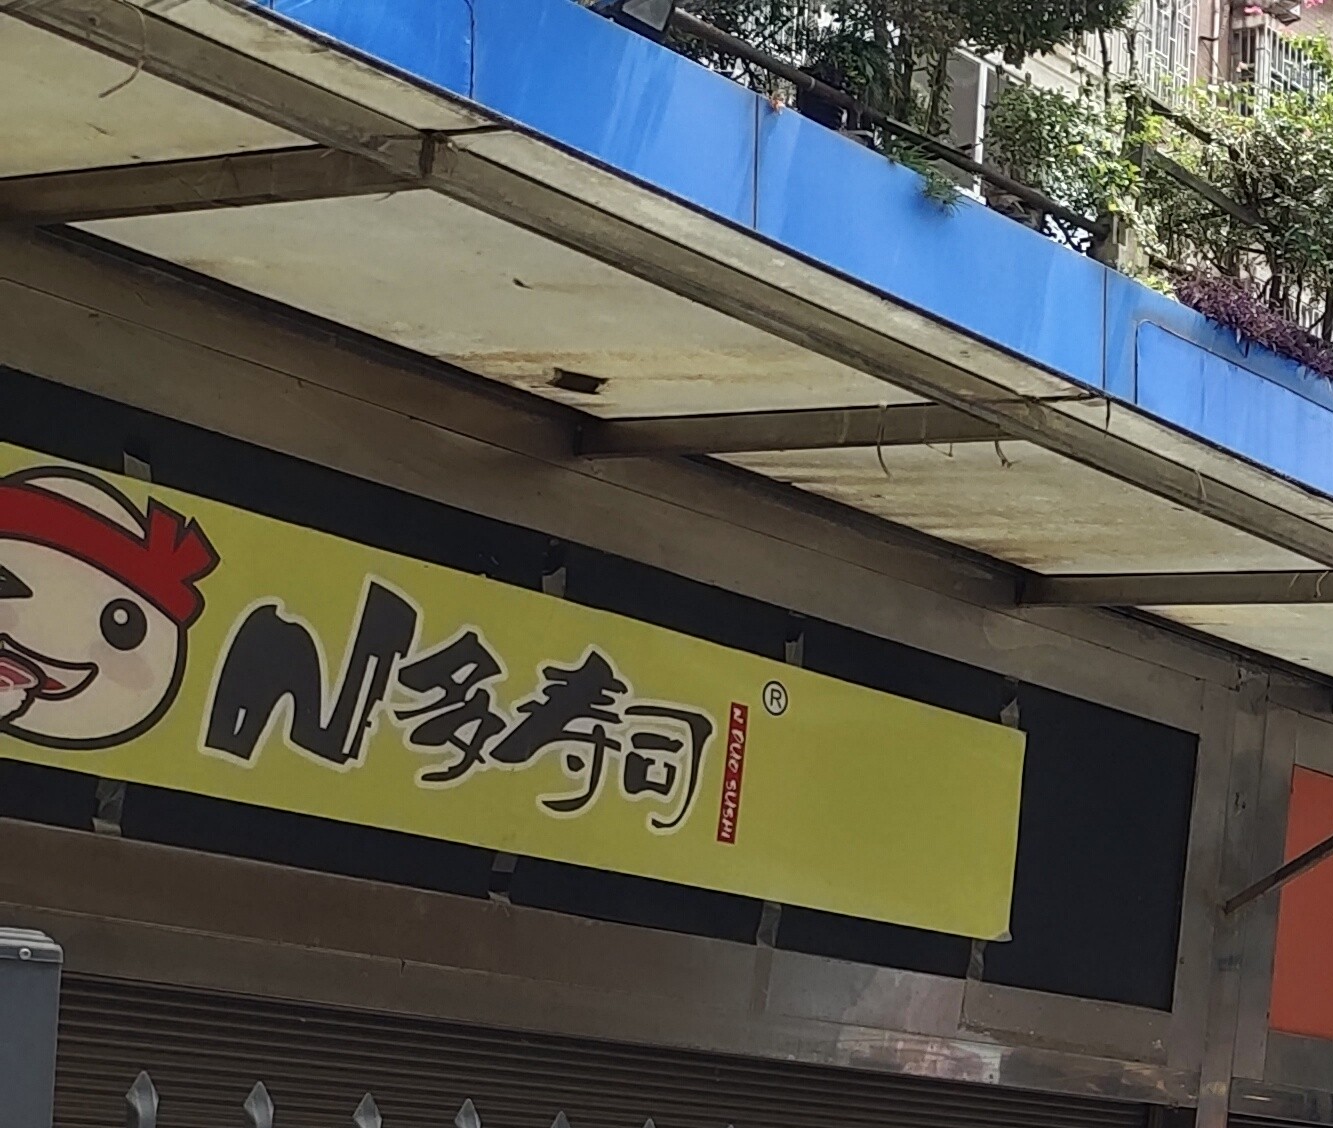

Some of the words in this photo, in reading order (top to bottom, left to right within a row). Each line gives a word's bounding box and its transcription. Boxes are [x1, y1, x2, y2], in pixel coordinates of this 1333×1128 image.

[204, 580, 714, 828] N多寿司
[720, 778, 737, 839] SUSHI
